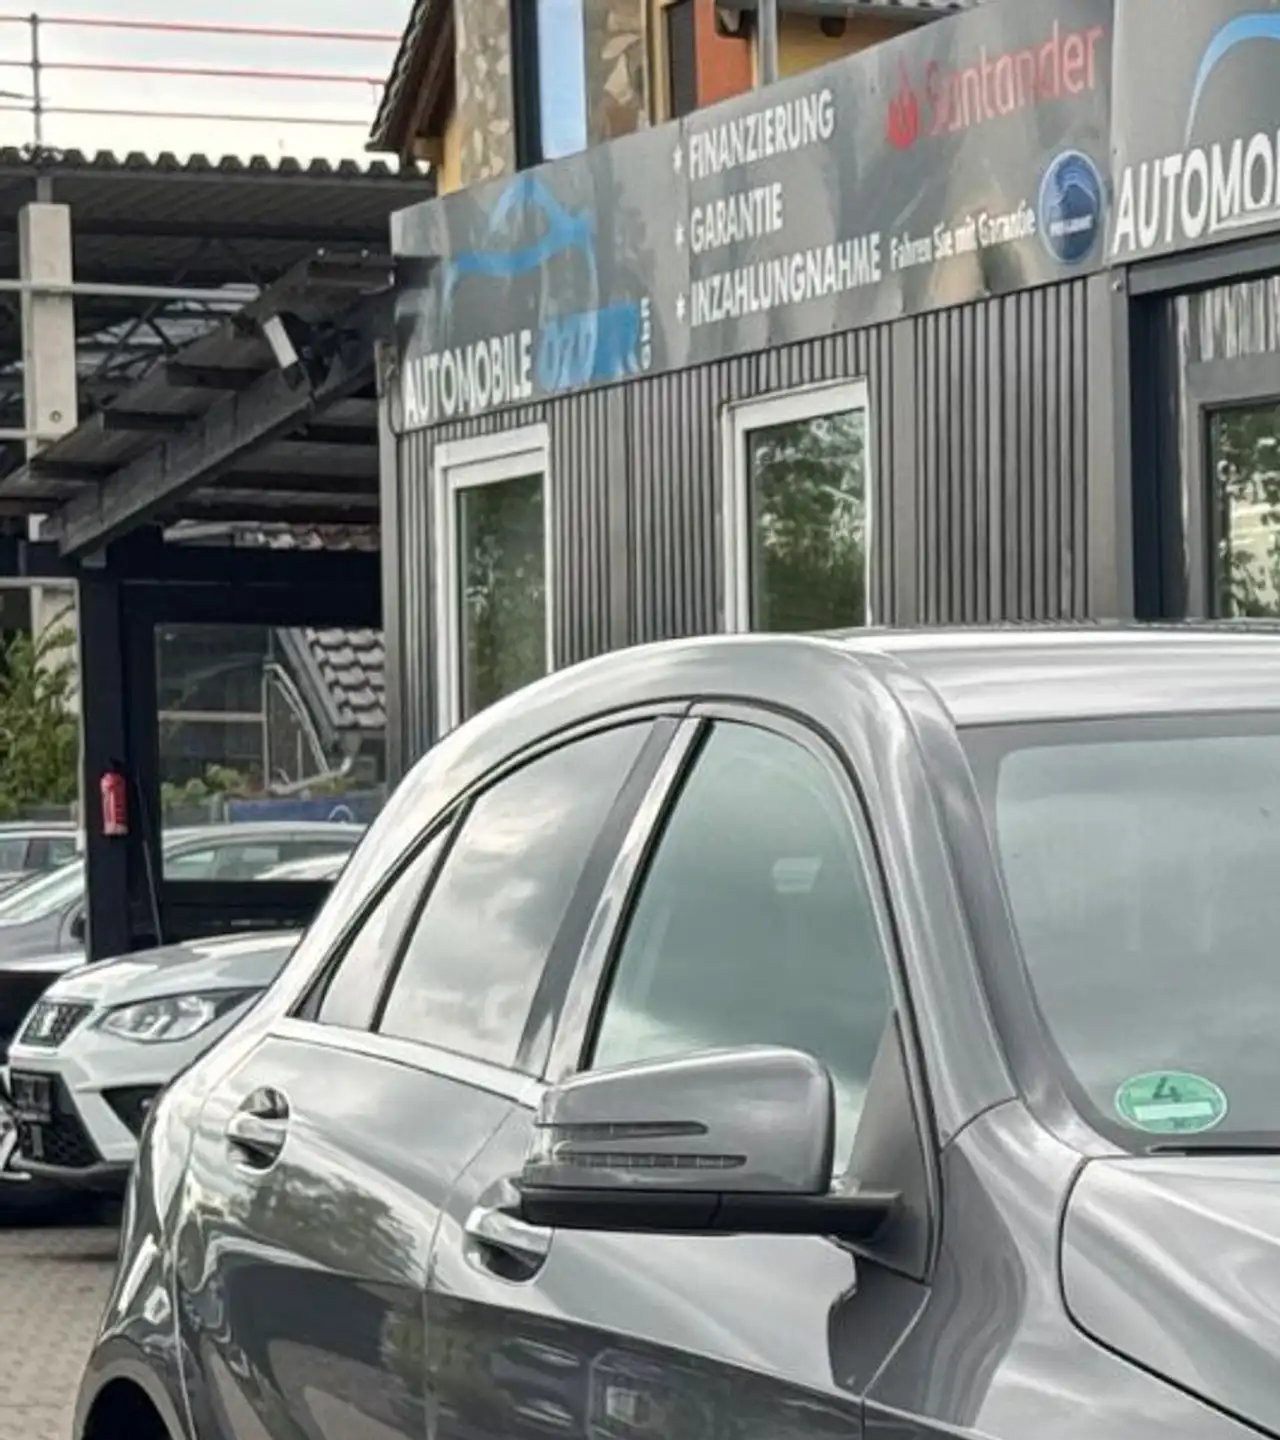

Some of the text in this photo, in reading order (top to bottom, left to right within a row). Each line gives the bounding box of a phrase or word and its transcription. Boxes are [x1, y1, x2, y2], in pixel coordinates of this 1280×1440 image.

[924, 19, 1104, 137] Santander
[689, 88, 834, 181] FINANZIERUNG
[691, 182, 783, 254] GARANTIE
[691, 232, 882, 327] INZAHLUNGNAHME
[404, 329, 533, 431] AUTOMOBILE
[1152, 1076, 1183, 1103] 4
